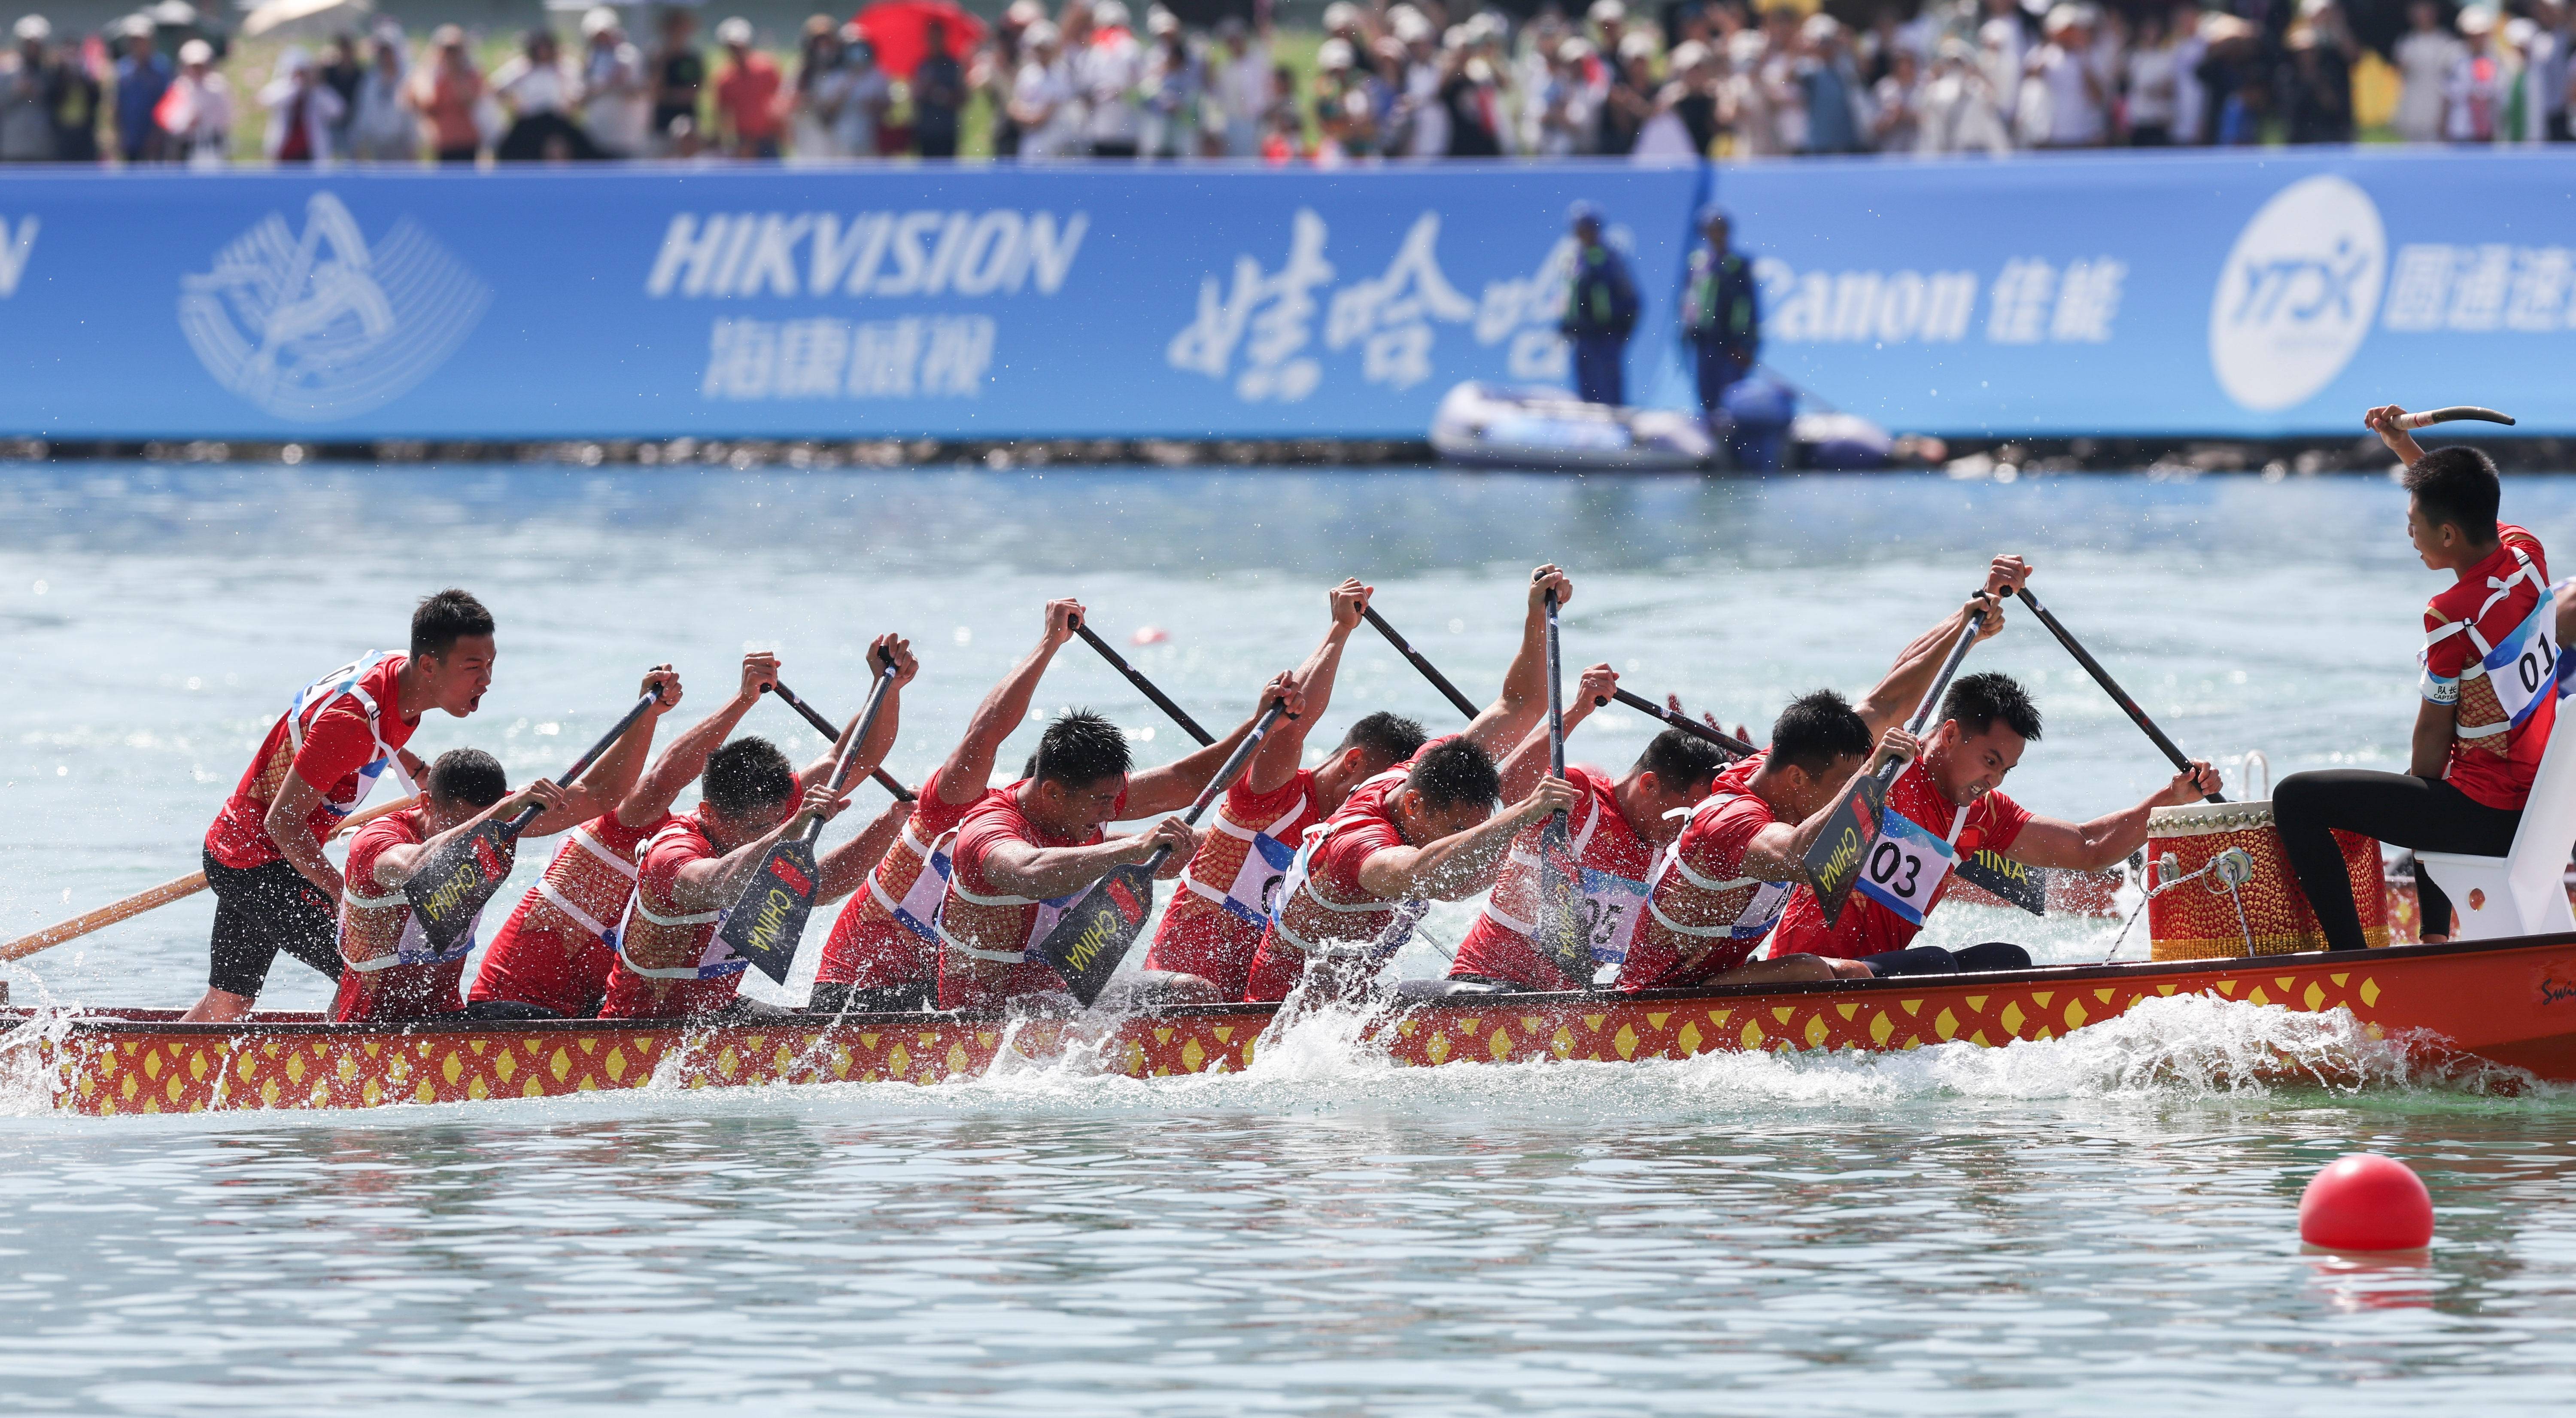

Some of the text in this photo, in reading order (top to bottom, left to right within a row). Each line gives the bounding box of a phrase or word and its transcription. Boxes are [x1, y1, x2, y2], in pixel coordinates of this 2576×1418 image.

[645, 210, 1090, 297] HIKVISION
[2385, 244, 2576, 331] 圆通速
[2438, 685, 2457, 694] 队长
[2519, 632, 2555, 693] 01
[1819, 827, 1857, 893] CHINA
[1871, 842, 1921, 898] 03
[423, 864, 476, 921] CHINA
[747, 889, 790, 951] CHINA
[1065, 910, 1117, 971] CHINA
[2542, 978, 2576, 1006] Swi
